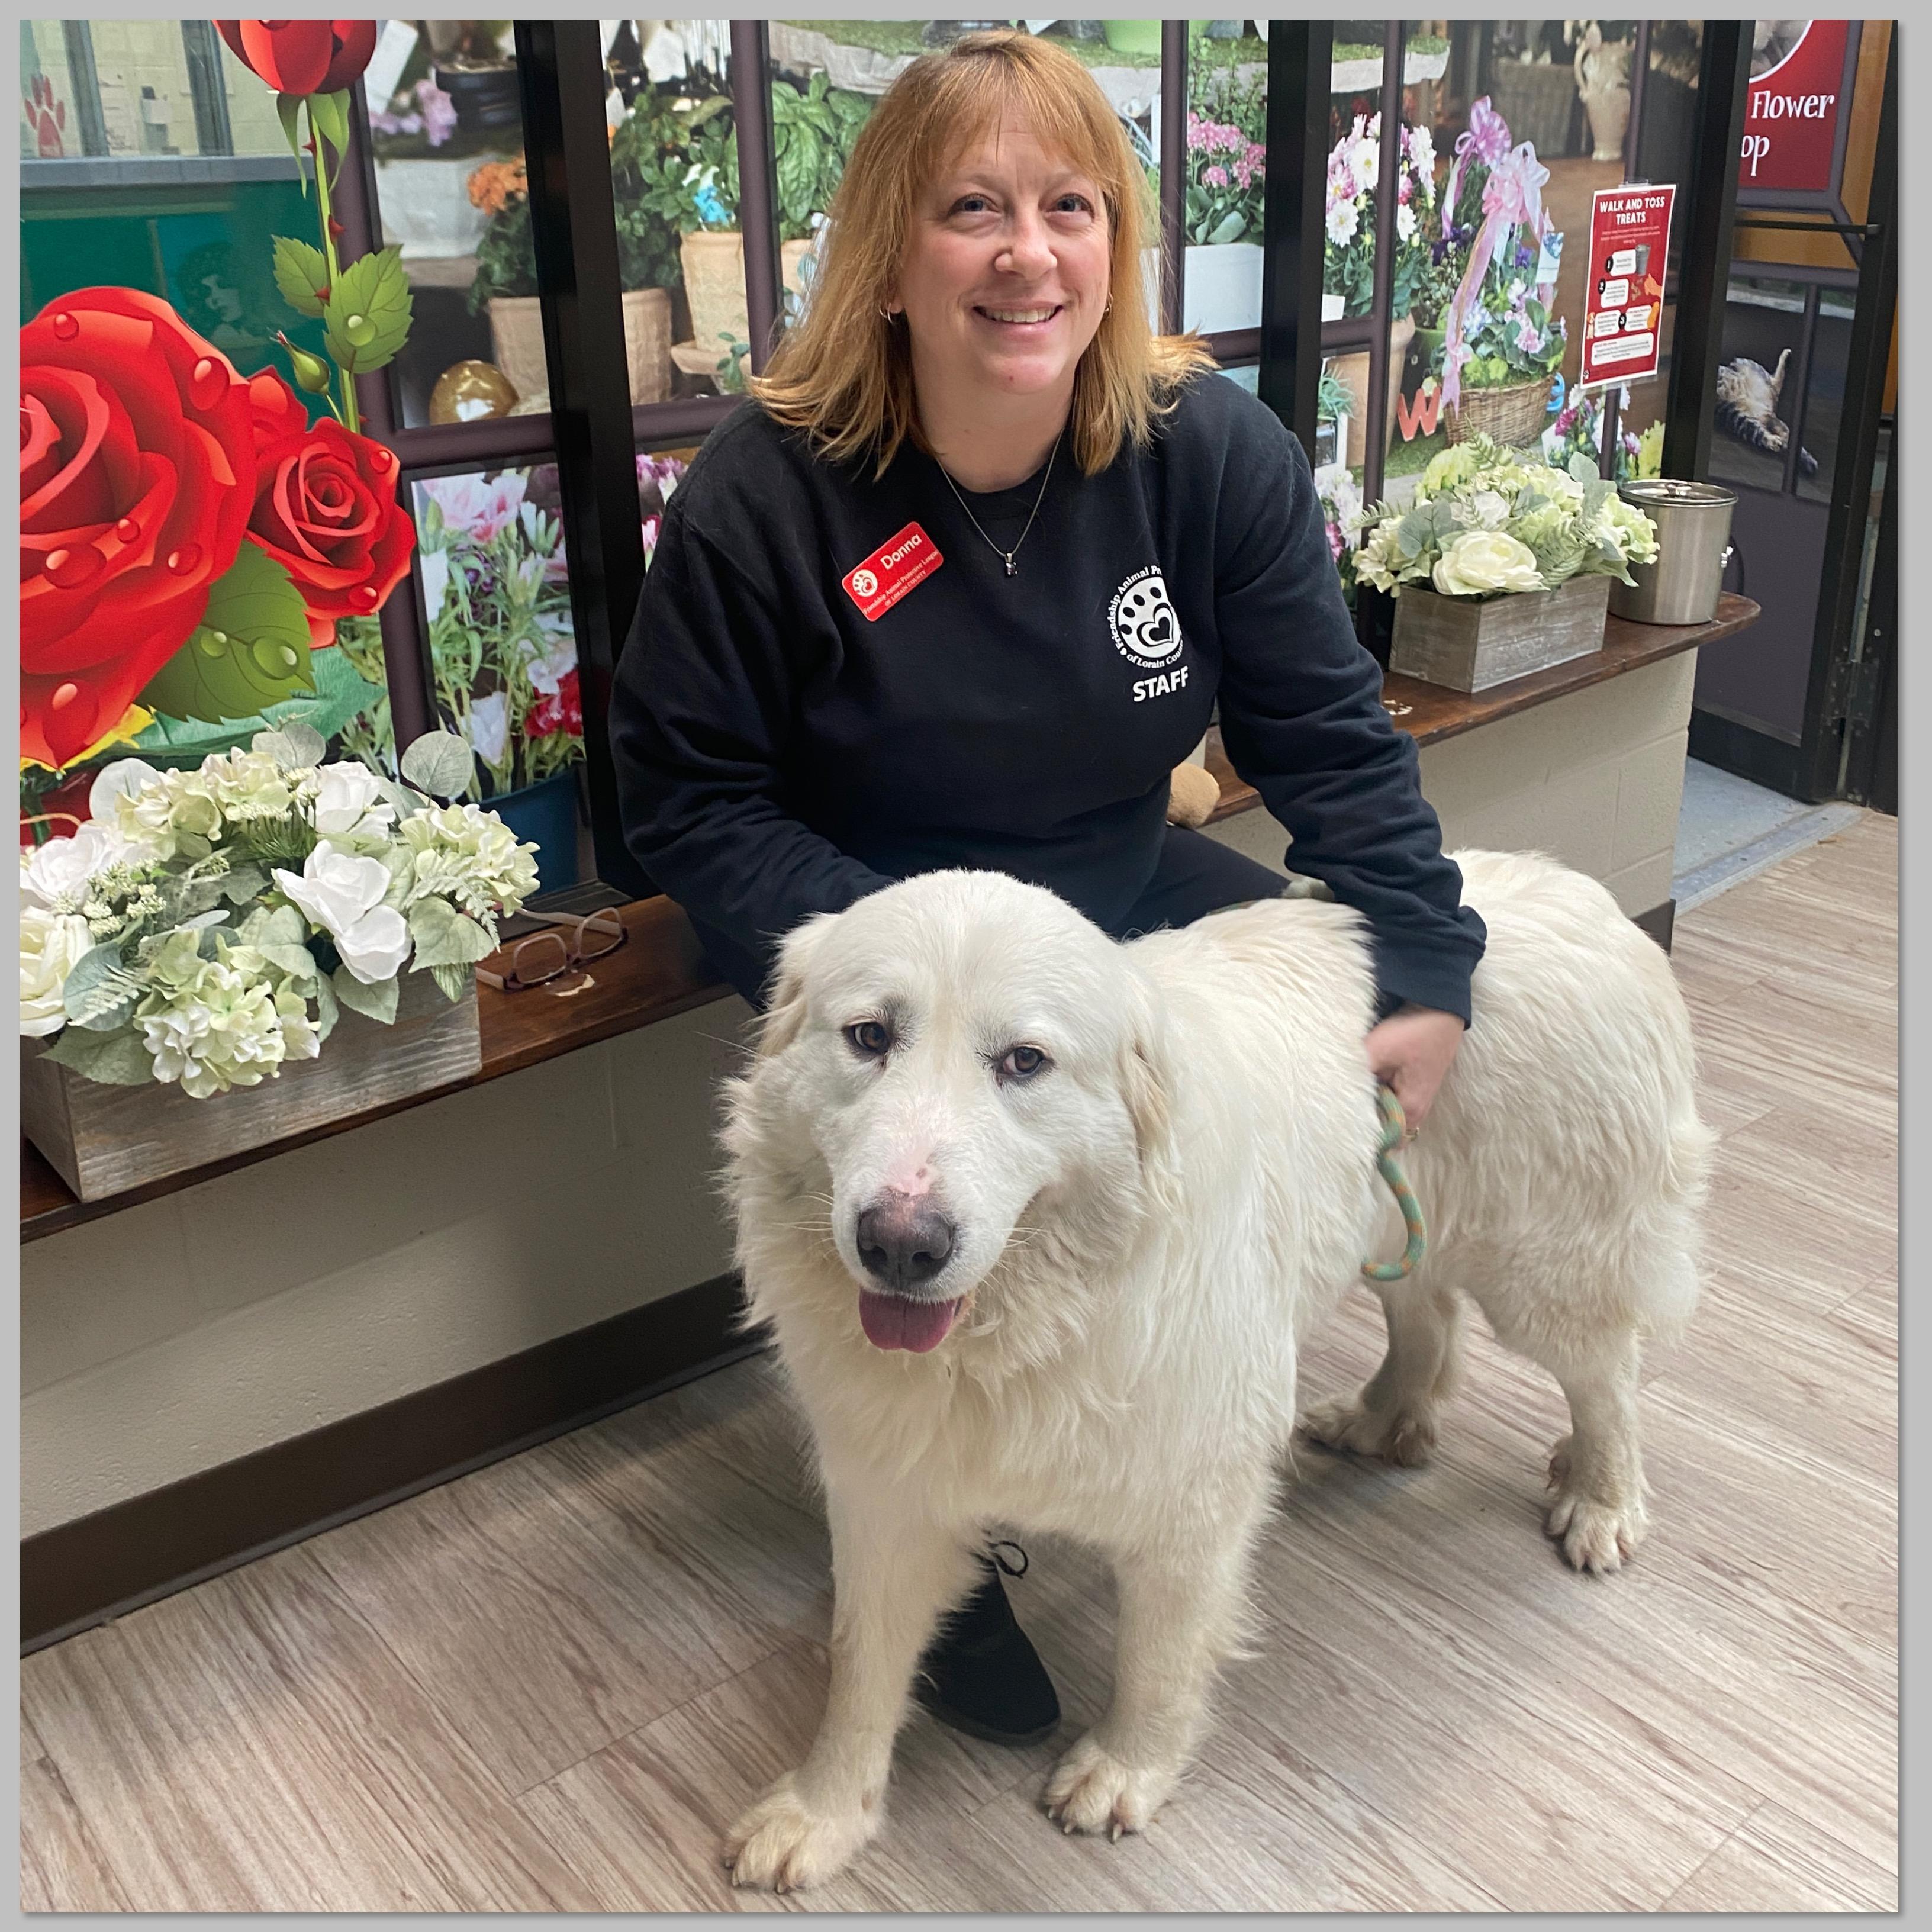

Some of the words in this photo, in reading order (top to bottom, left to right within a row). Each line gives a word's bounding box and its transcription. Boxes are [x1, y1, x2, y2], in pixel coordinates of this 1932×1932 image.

[1751, 90, 1835, 119] Flower
[1599, 200, 1624, 214] WALK
[1625, 198, 1643, 211] AND
[1644, 196, 1666, 209] TOSS
[1615, 211, 1647, 226] TREATS
[1599, 281, 1605, 291] 2
[1619, 316, 1625, 325] 3
[1396, 386, 1441, 442] W
[880, 534, 923, 570] Donna
[885, 579, 902, 597] Animal
[1107, 594, 1125, 650] Friendship
[1117, 566, 1149, 595] Animal
[1126, 653, 1139, 664] of
[1136, 659, 1165, 669] Lorain
[1132, 665, 1189, 702] STAFF
